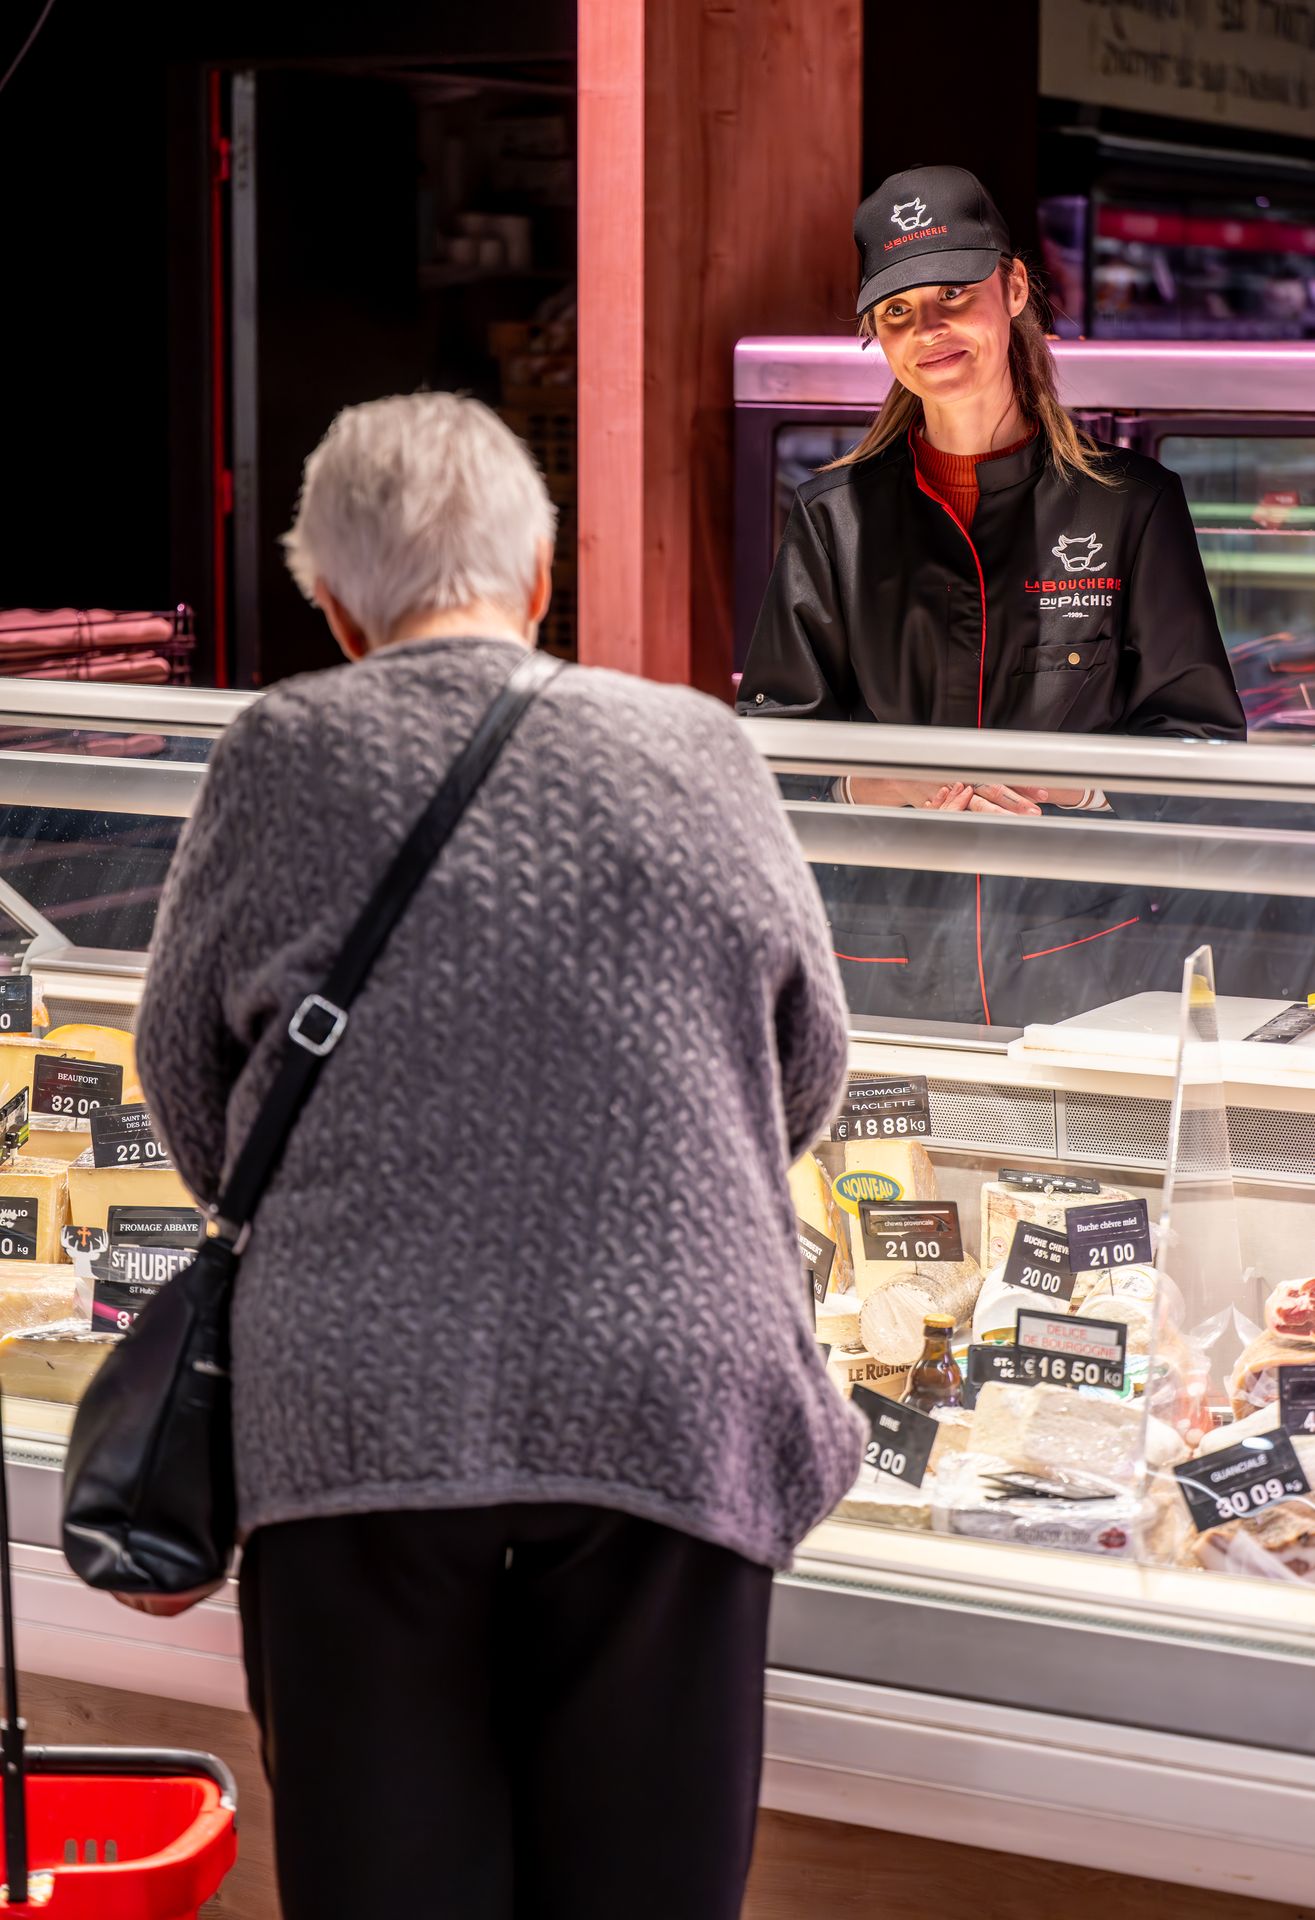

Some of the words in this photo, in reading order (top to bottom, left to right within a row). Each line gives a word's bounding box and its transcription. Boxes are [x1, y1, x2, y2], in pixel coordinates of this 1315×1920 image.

[57, 1072, 98, 1085] BEAUFORT
[849, 1087, 911, 1098] FROMAGE
[852, 1100, 916, 1111] RACLETTE
[121, 1115, 140, 1124] SAINT
[126, 1121, 140, 1129] DES
[910, 1119, 926, 1132] kg
[842, 1177, 894, 1201] NOUVEAU
[120, 1223, 162, 1232] FROMAGE
[164, 1223, 199, 1232] ABBAYE
[1076, 1223, 1099, 1233] Buche
[1122, 1216, 1137, 1227] miel
[1023, 1234, 1048, 1249] BUCHE
[1050, 1253, 1062, 1263] MG
[1046, 1323, 1087, 1339] DELICE
[1023, 1334, 1038, 1346] DE
[1041, 1337, 1115, 1359] BOURGOGNE
[848, 1369, 864, 1382] LE
[1104, 1368, 1122, 1387] kg
